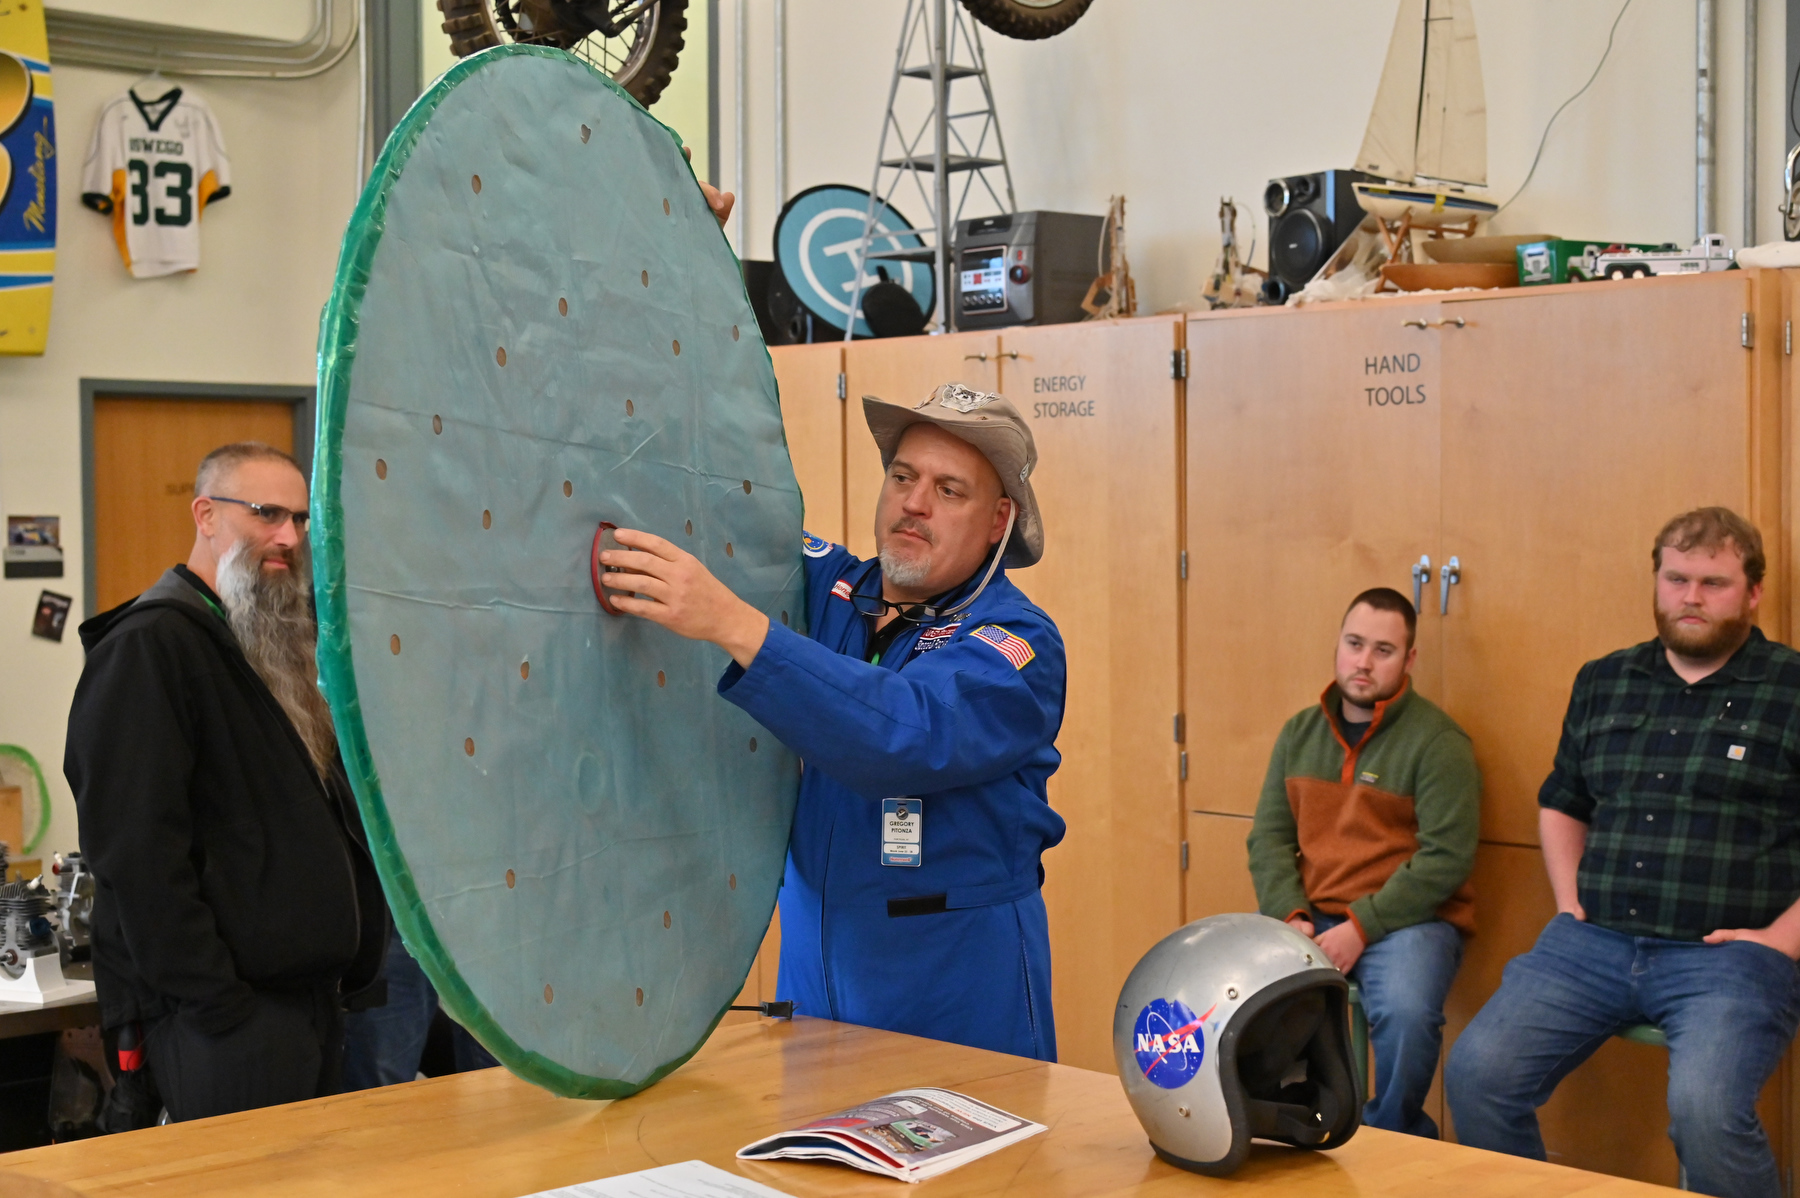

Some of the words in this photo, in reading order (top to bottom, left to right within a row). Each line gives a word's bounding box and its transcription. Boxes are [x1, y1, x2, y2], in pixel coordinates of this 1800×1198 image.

[128, 159, 193, 227] 33
[1364, 352, 1421, 375] HAND
[1033, 374, 1087, 394] ENERGY
[1363, 383, 1427, 407] TOOLS
[1033, 400, 1096, 419] STORAGE
[1136, 1032, 1201, 1054] NASA
